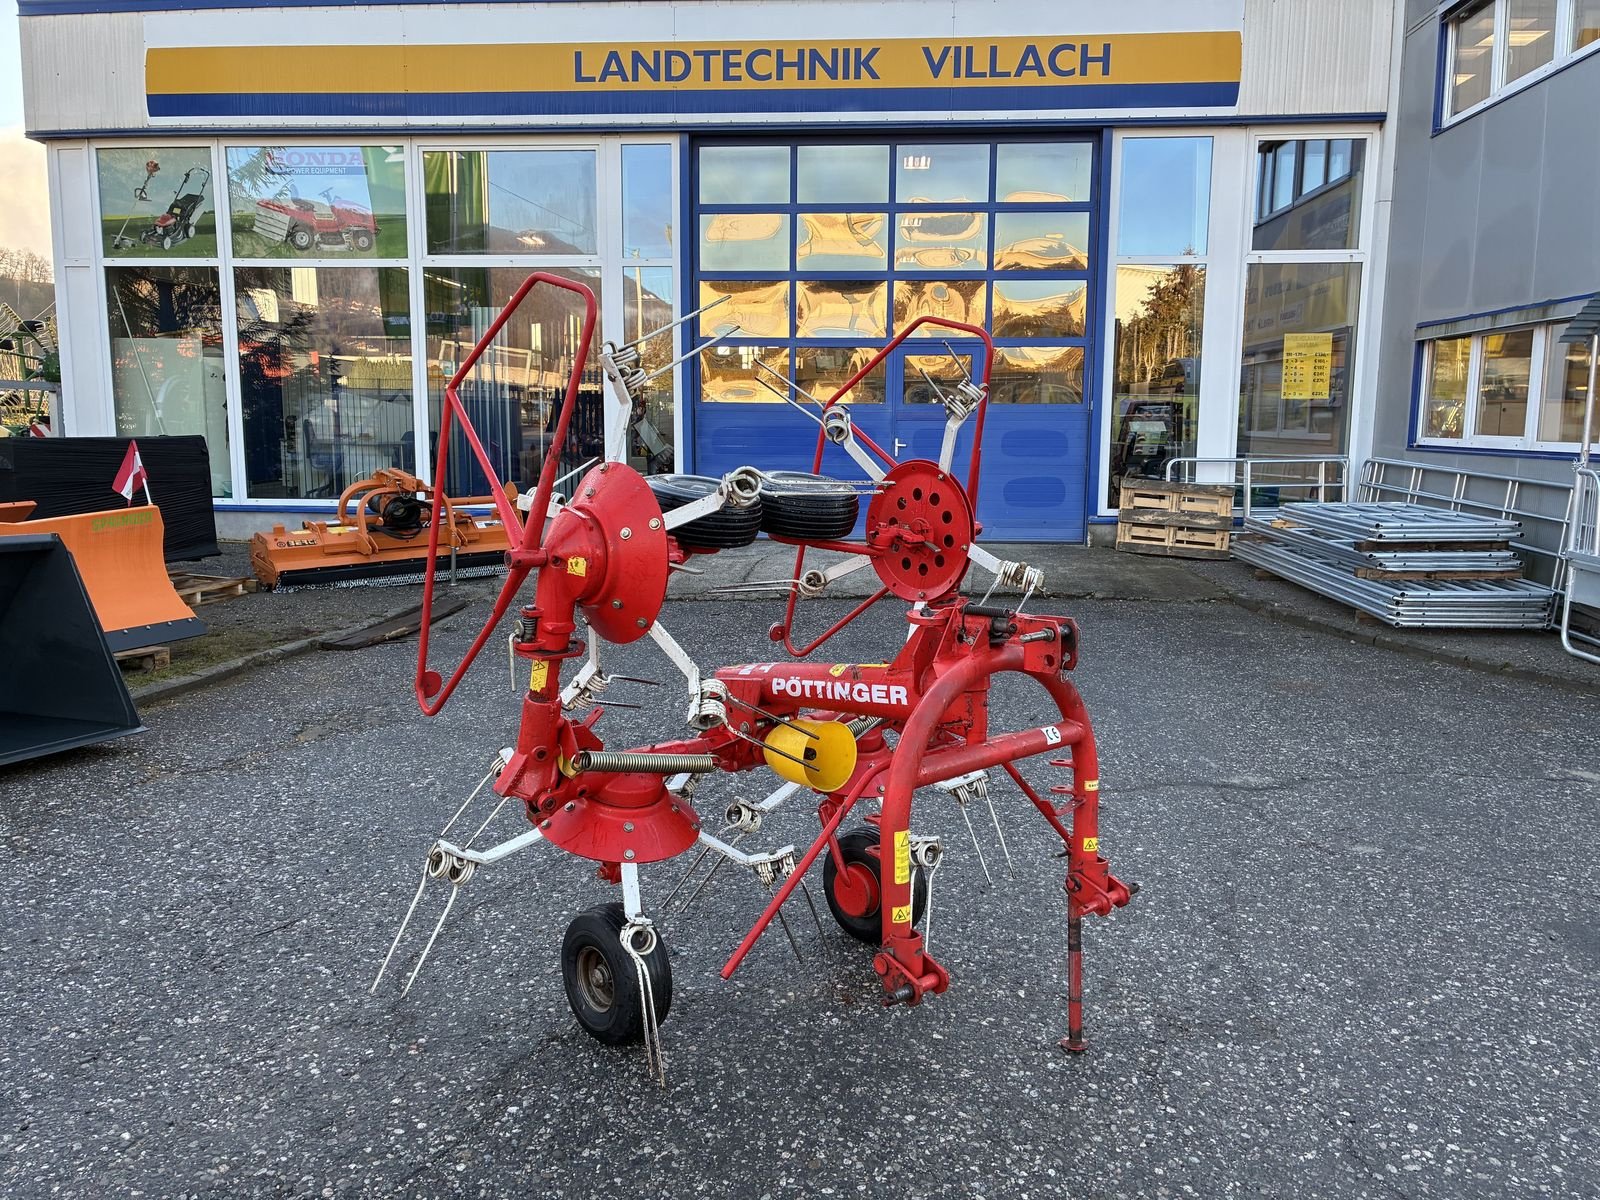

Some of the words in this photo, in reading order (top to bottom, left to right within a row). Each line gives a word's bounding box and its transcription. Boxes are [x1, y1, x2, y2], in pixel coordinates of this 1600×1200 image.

[574, 47, 881, 83] LANDTECHNIK
[921, 43, 1111, 79] VILLACH
[311, 167, 346, 175] EQUIPMENT
[771, 676, 909, 706] PÖTTINGER
